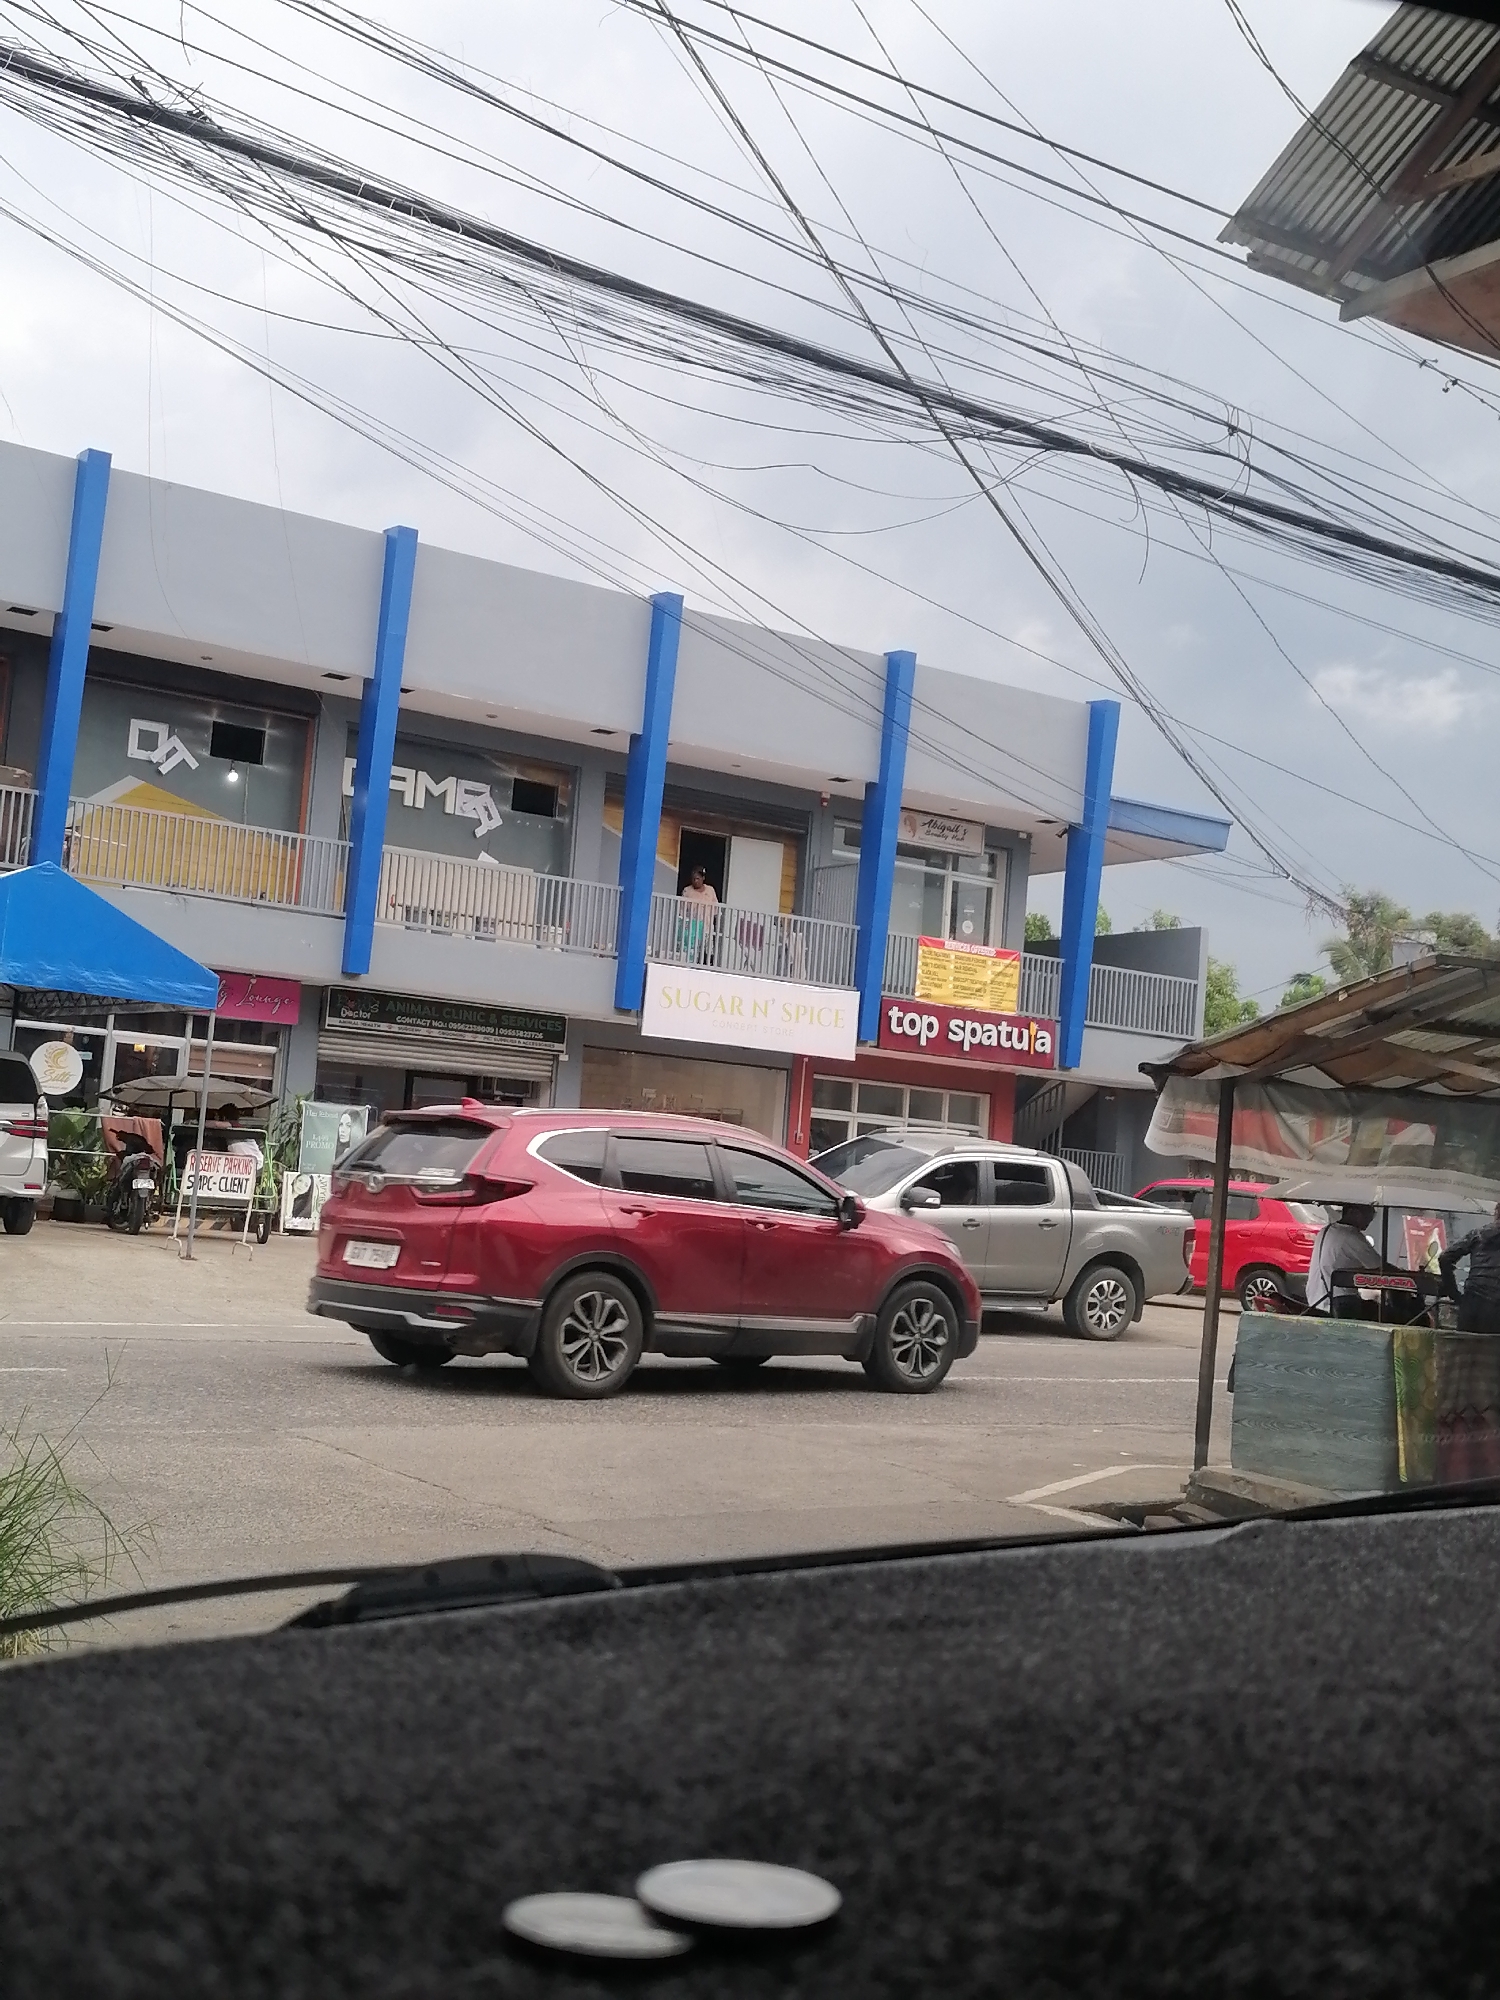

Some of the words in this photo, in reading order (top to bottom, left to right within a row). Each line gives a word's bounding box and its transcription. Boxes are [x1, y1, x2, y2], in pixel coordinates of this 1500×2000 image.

[921, 819, 968, 836] Abigail's
[235, 979, 294, 1015] Lounge
[340, 1007, 371, 1020] Doctor
[385, 1000, 439, 1017] ANIMAL
[443, 1007, 486, 1022] CLINIC
[489, 1013, 497, 1024] &
[501, 1014, 563, 1032] SERVICES
[659, 986, 745, 1016] SUGAR
[752, 997, 776, 1018] N'
[781, 1002, 845, 1029] SPICE
[396, 1015, 431, 1027] CONTACT
[712, 1019, 758, 1032] CONCEPT
[763, 1025, 795, 1037] STORE
[888, 1005, 940, 1047] top
[305, 1140, 335, 1150] PROMO
[189, 1153, 222, 1173] RSERVE
[223, 1157, 254, 1176] PARKING
